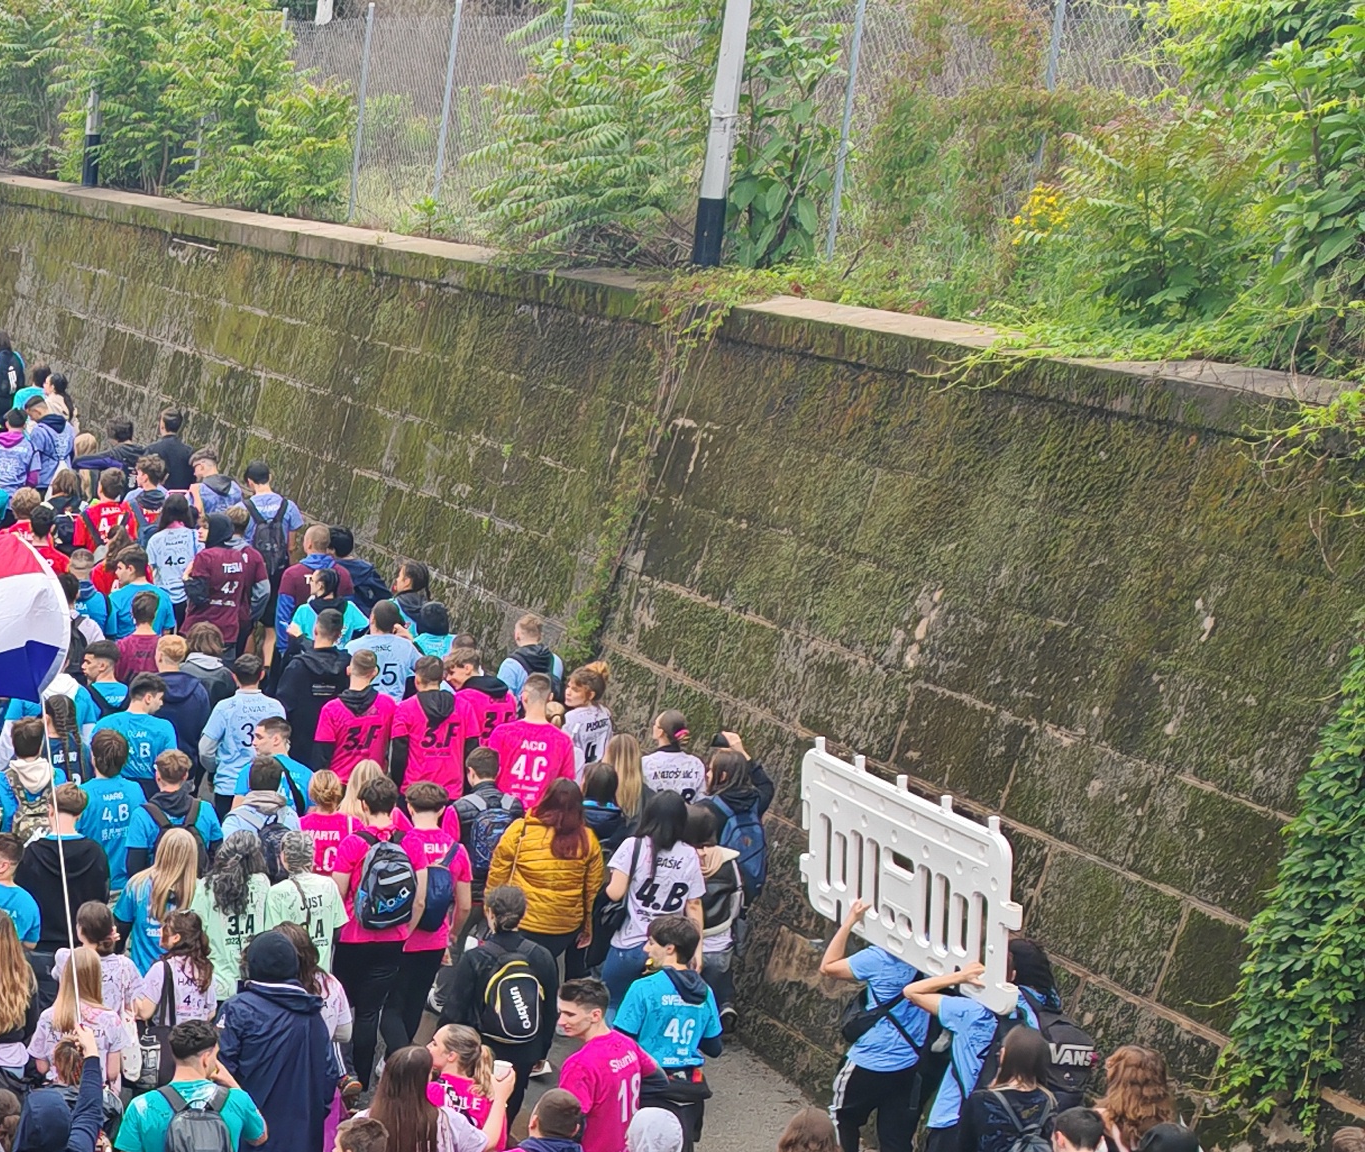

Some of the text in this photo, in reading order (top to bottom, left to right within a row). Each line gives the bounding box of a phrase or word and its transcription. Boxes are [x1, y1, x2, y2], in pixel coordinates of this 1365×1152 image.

[222, 561, 243, 574] TESLA
[343, 723, 381, 753] 3.F
[421, 721, 461, 748] 3.F
[521, 740, 546, 751] ACO
[512, 754, 547, 784] 4.C
[103, 804, 130, 826] 4.B
[635, 877, 690, 910] 4.B
[228, 916, 255, 936] 3.A
[509, 985, 531, 1030] umbro
[1050, 1044, 1094, 1066] VANS
